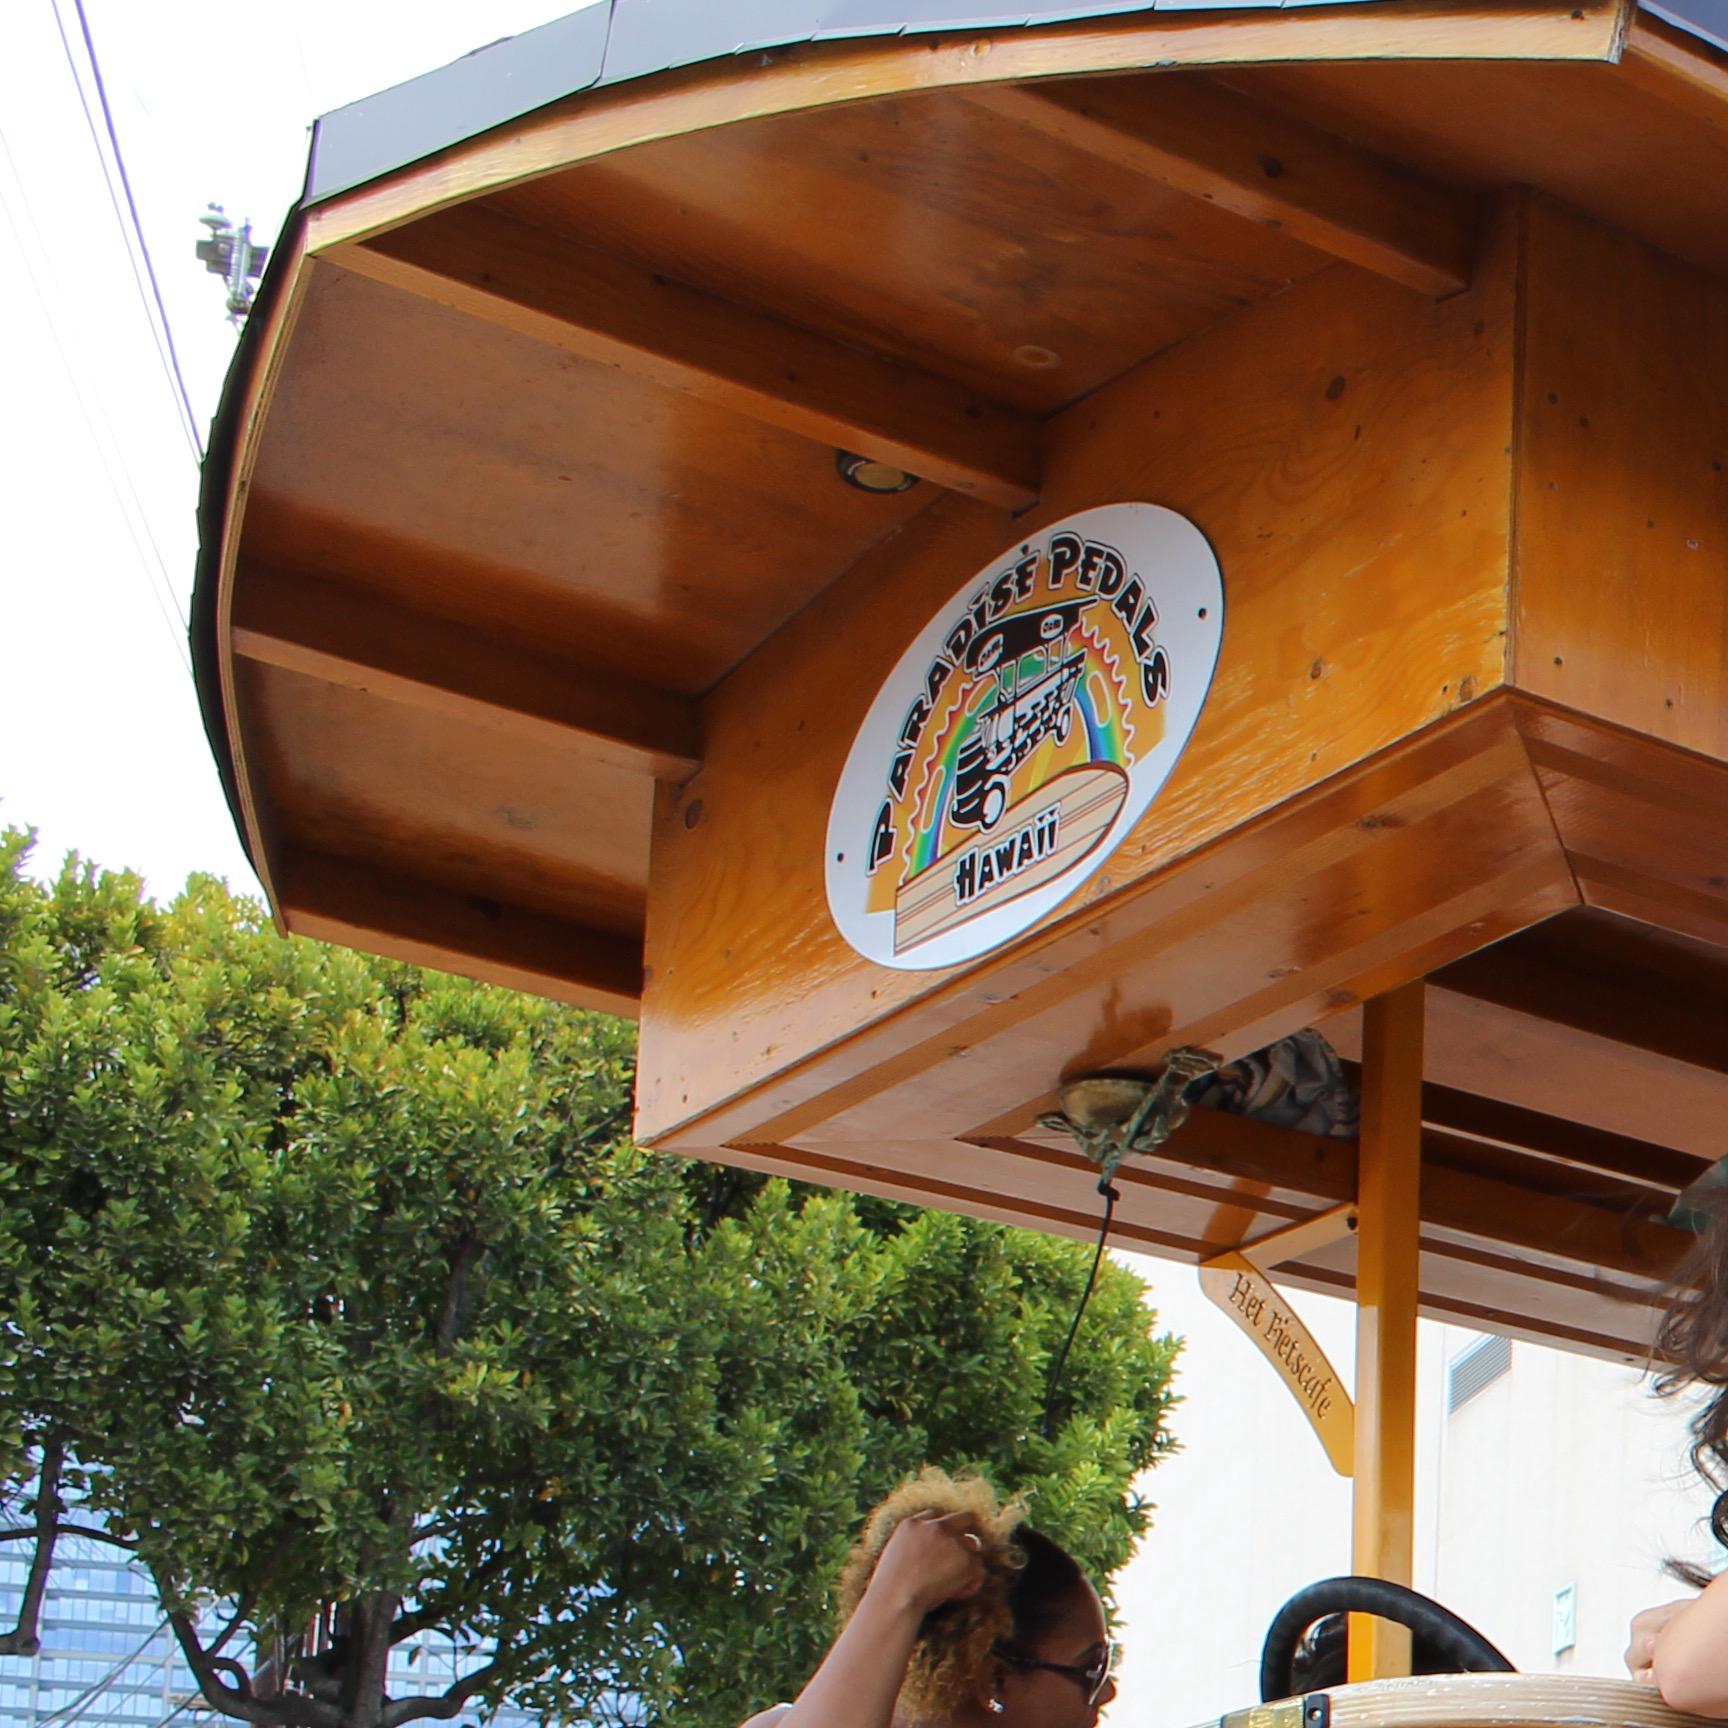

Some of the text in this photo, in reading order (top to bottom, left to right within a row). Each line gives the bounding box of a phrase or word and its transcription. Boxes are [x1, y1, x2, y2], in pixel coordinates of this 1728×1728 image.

[868, 533, 1169, 874] PARADISE PEDALS
[955, 802, 1060, 905] HAWAII
[1228, 1272, 1332, 1418] Het Fietscafe
